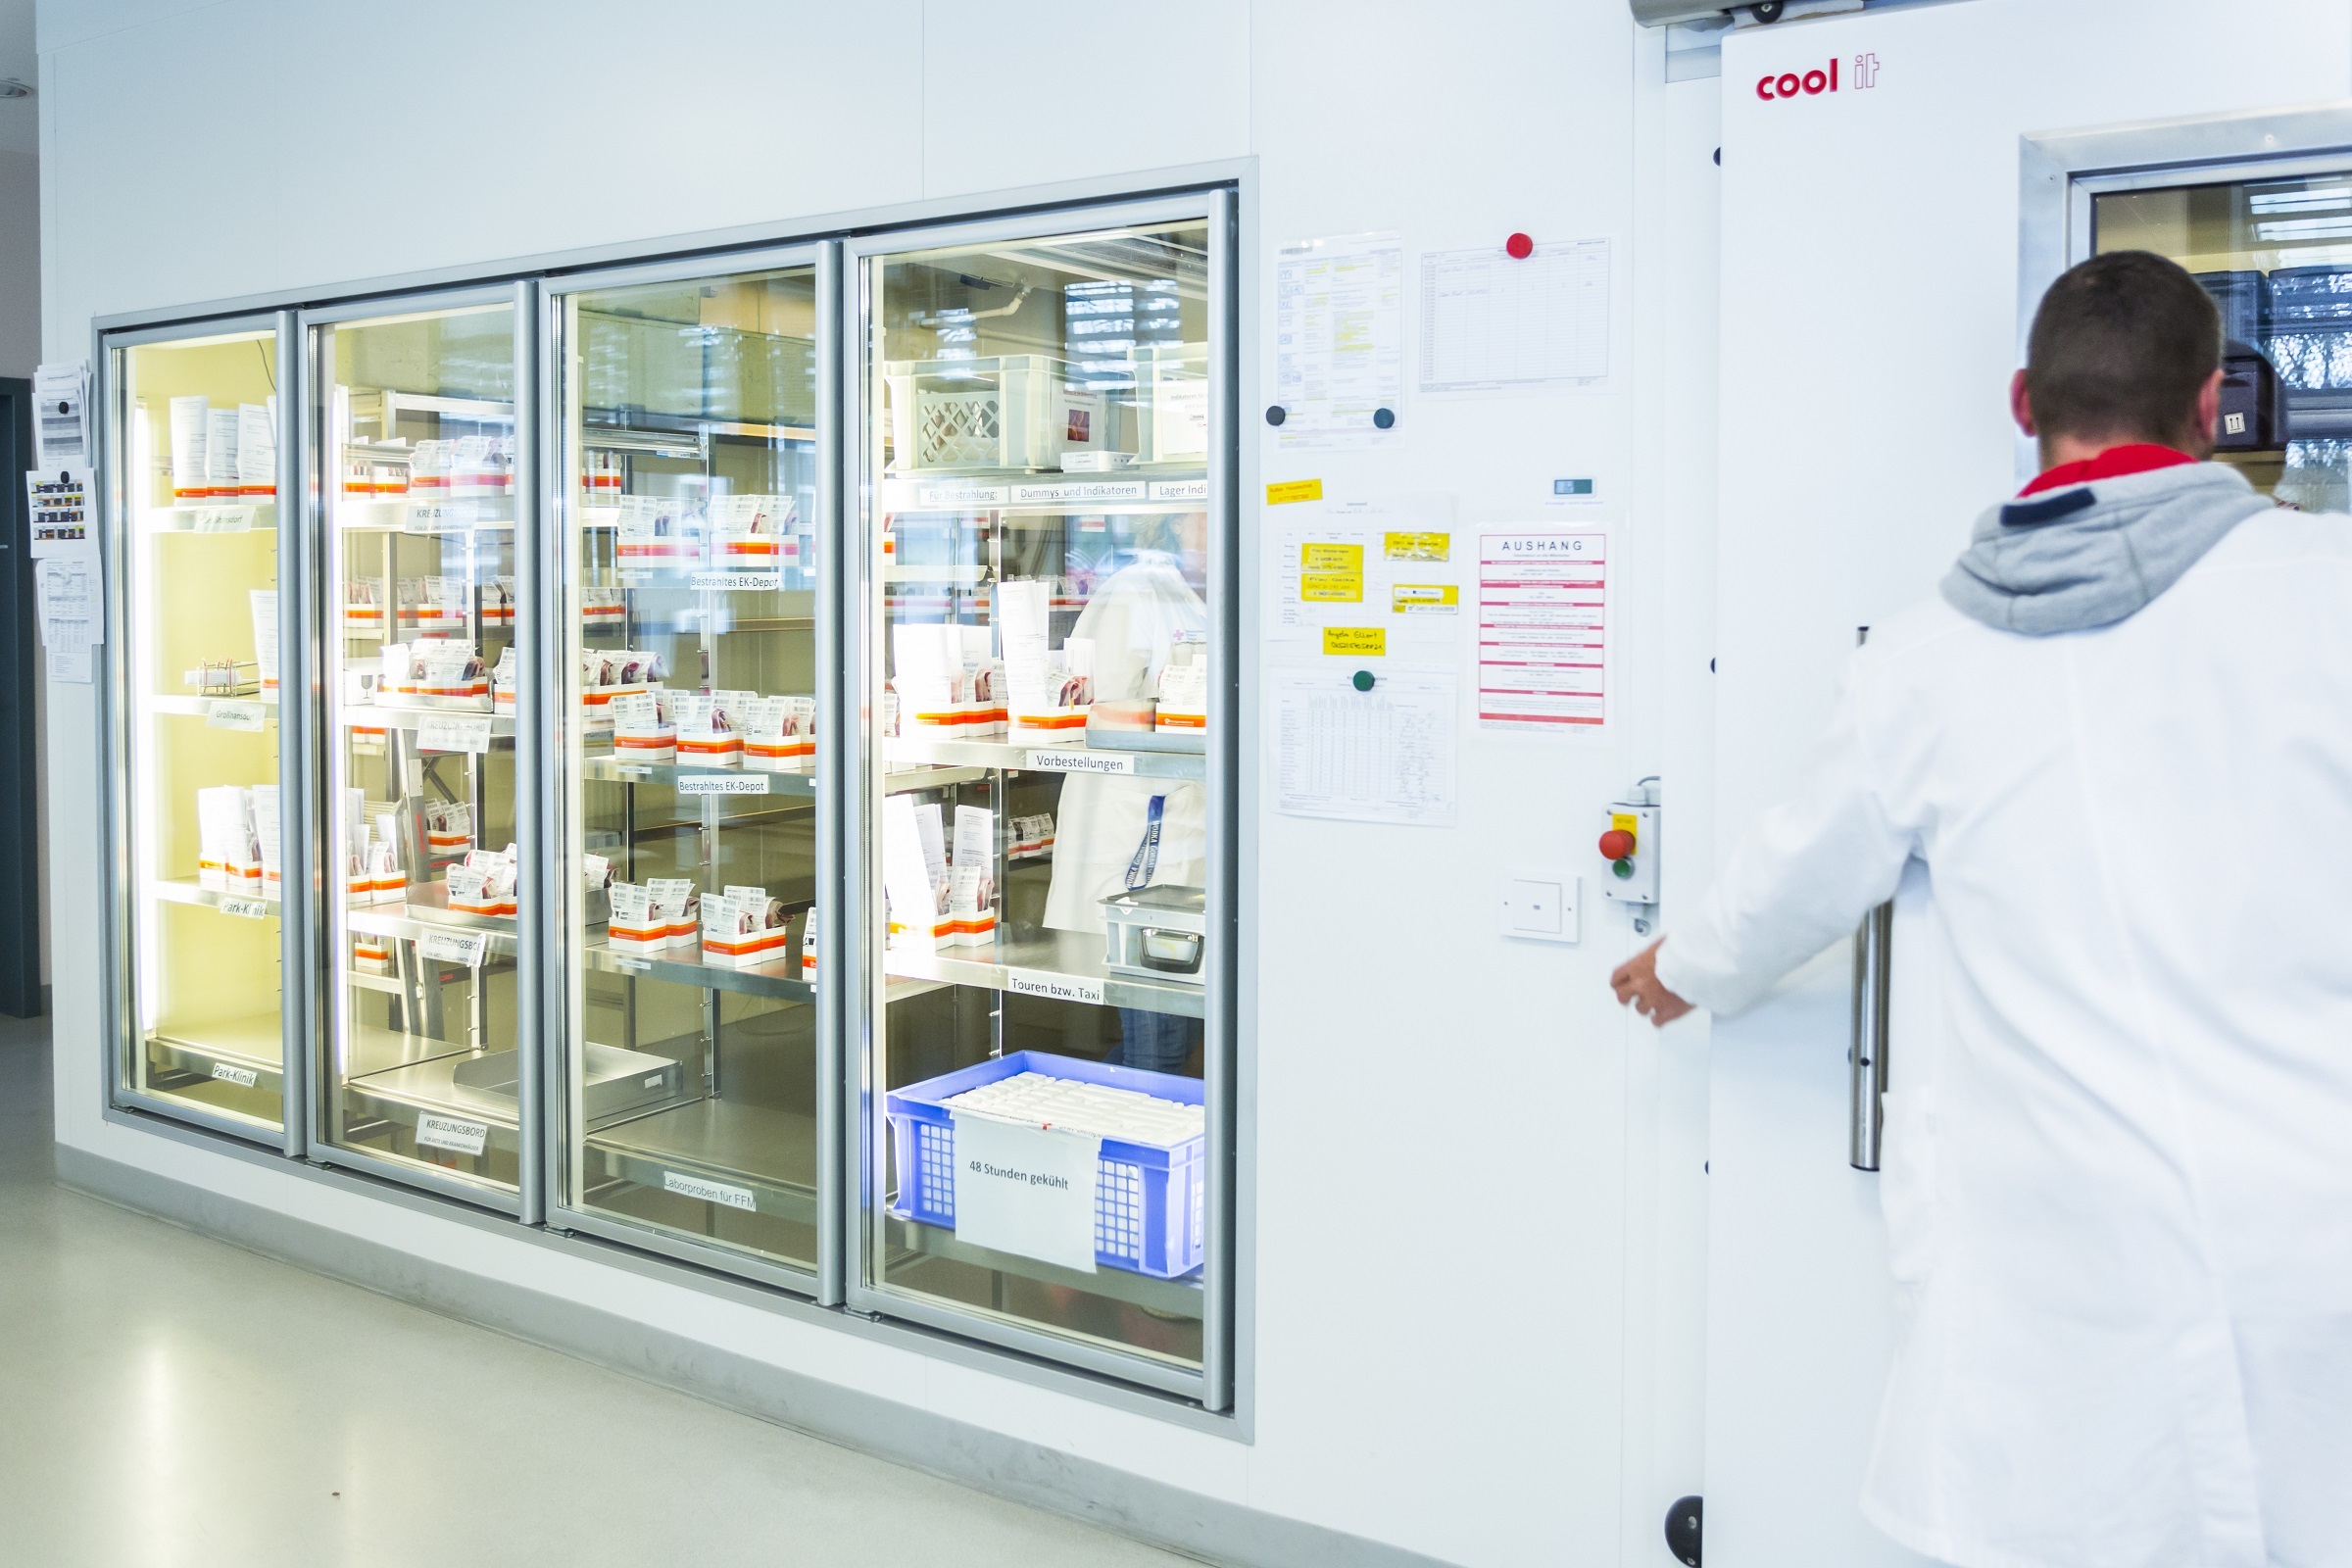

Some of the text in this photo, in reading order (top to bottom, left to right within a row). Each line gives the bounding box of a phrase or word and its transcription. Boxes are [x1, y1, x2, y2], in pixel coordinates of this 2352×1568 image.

[1755, 53, 1880, 102] cool it
[945, 489, 998, 501] Bestrahlung:
[1020, 486, 1137, 499] Dummys und Indikatoren
[1159, 486, 1186, 498] Lager
[1501, 540, 1583, 551] AUSHANG
[691, 576, 778, 589] Bestrahltes EK-Depot
[1036, 755, 1123, 772] Vorbestellungen
[679, 781, 764, 793] Bestrahltes EK-Depot
[222, 902, 265, 916] Park-Klnik
[1011, 978, 1100, 1000] Touren bzw. Taxi
[214, 1064, 255, 1085] Park-Klinik
[426, 1118, 485, 1138] KREUZUNGSBORD
[969, 1160, 1068, 1190] 48 Stunden gekühlt
[664, 1175, 756, 1208] Laborproben für FFM
